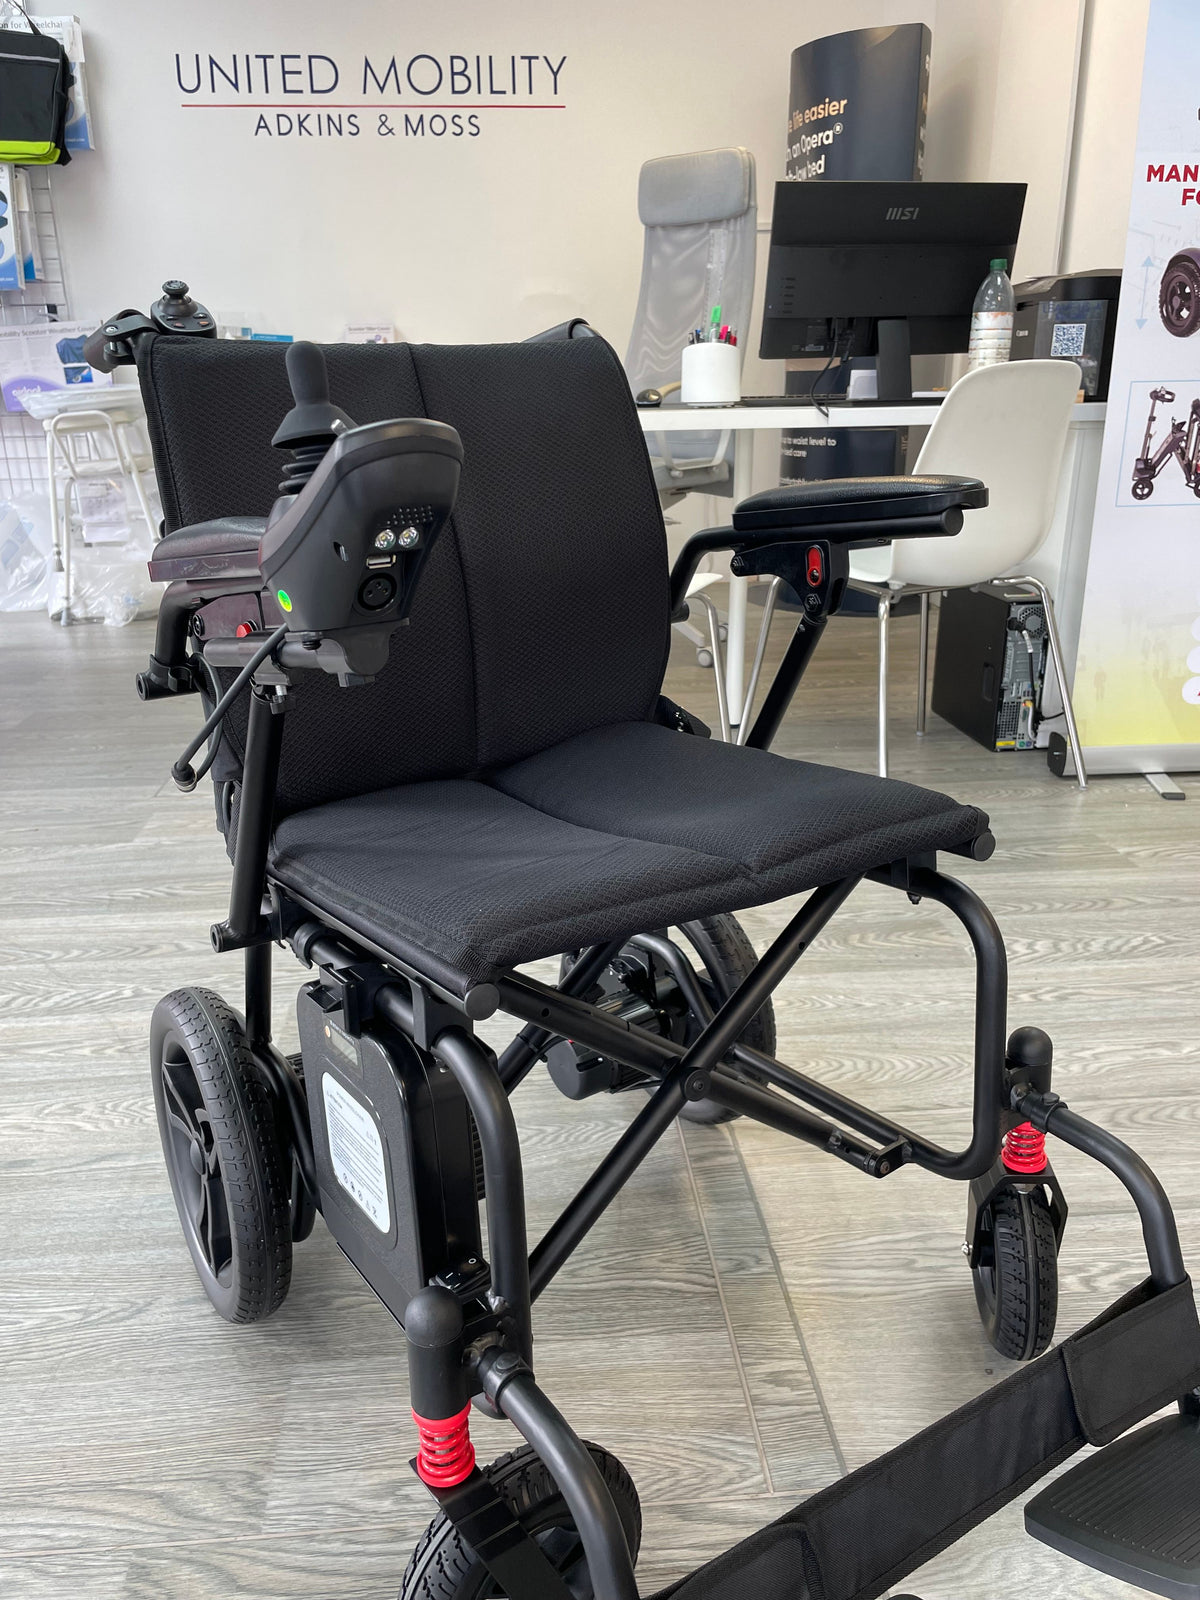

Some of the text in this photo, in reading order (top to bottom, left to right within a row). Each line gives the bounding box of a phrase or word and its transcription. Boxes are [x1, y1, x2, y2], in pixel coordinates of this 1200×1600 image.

[11, 21, 22, 29] for
[175, 53, 568, 96] UNITED MOBILITY
[804, 97, 848, 123] easier
[254, 113, 481, 137] ADKINS & MOSS
[807, 154, 826, 178] bed
[809, 437, 826, 446] level
[827, 438, 837, 447] to
